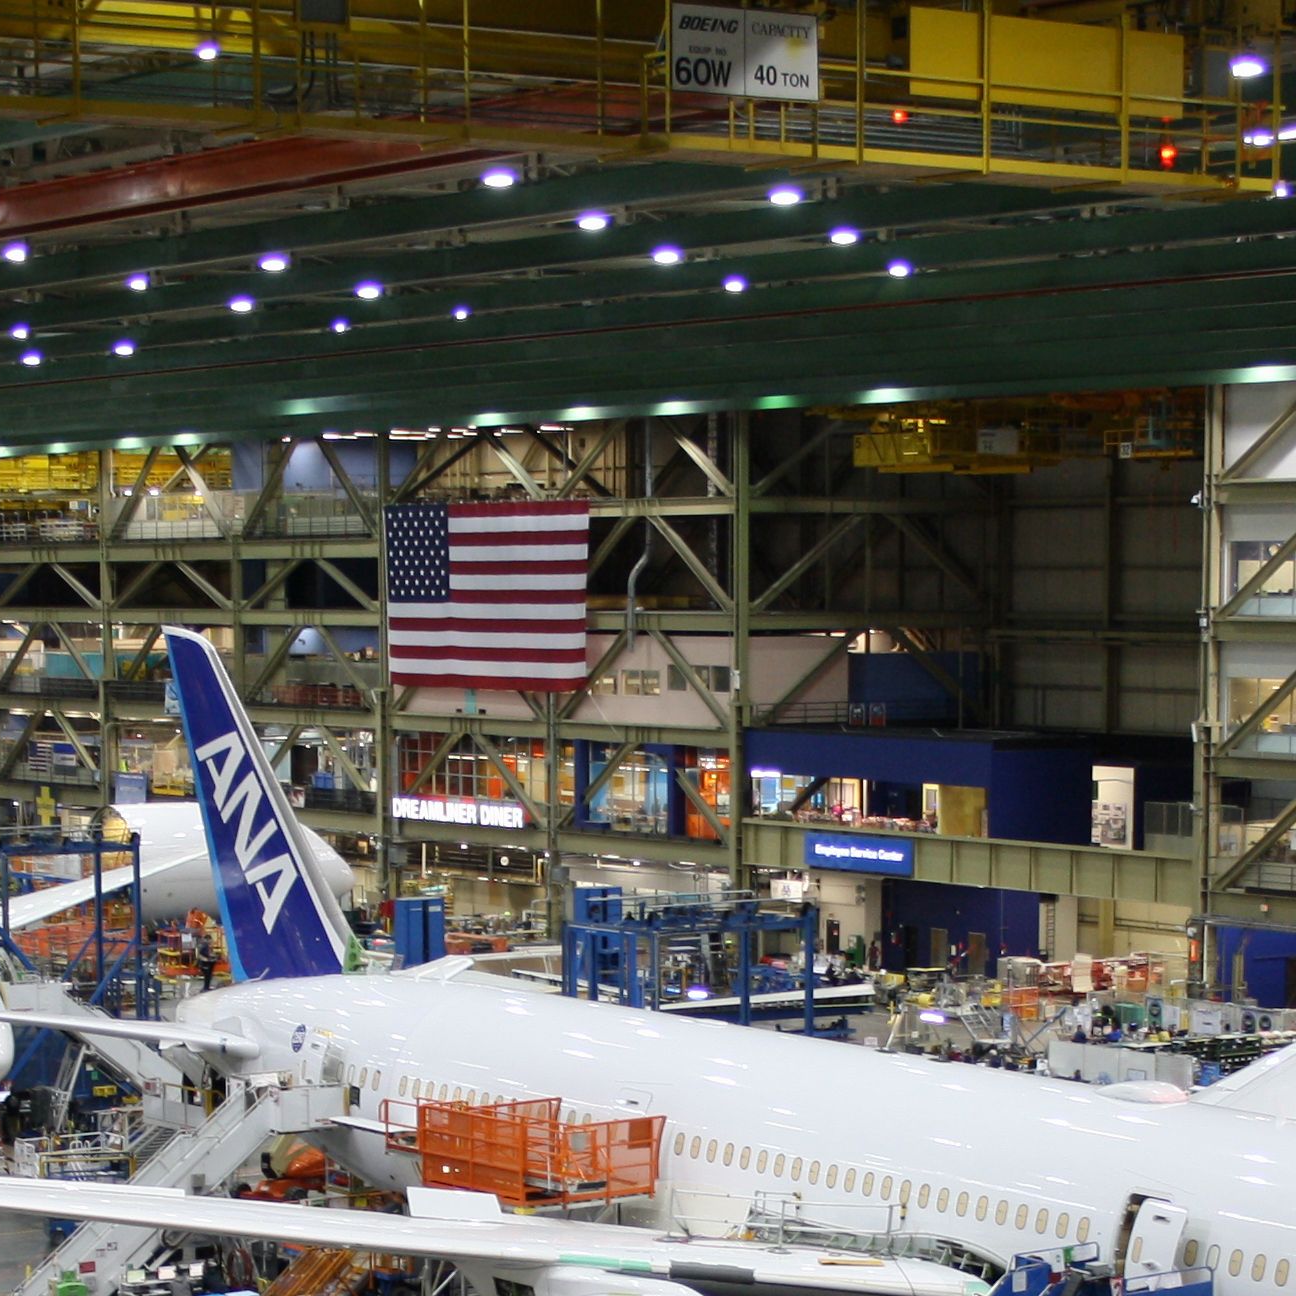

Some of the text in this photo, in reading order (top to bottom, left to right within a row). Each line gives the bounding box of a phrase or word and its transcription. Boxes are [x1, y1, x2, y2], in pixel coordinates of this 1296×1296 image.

[678, 15, 739, 34] BOEING
[751, 22, 810, 39] CAPACITY
[675, 56, 732, 87] 60W
[754, 64, 810, 88] 40 TON
[392, 797, 523, 828] DREAMLINER DINER
[194, 731, 299, 935] ANA
[815, 843, 904, 862] Employee Service Center
